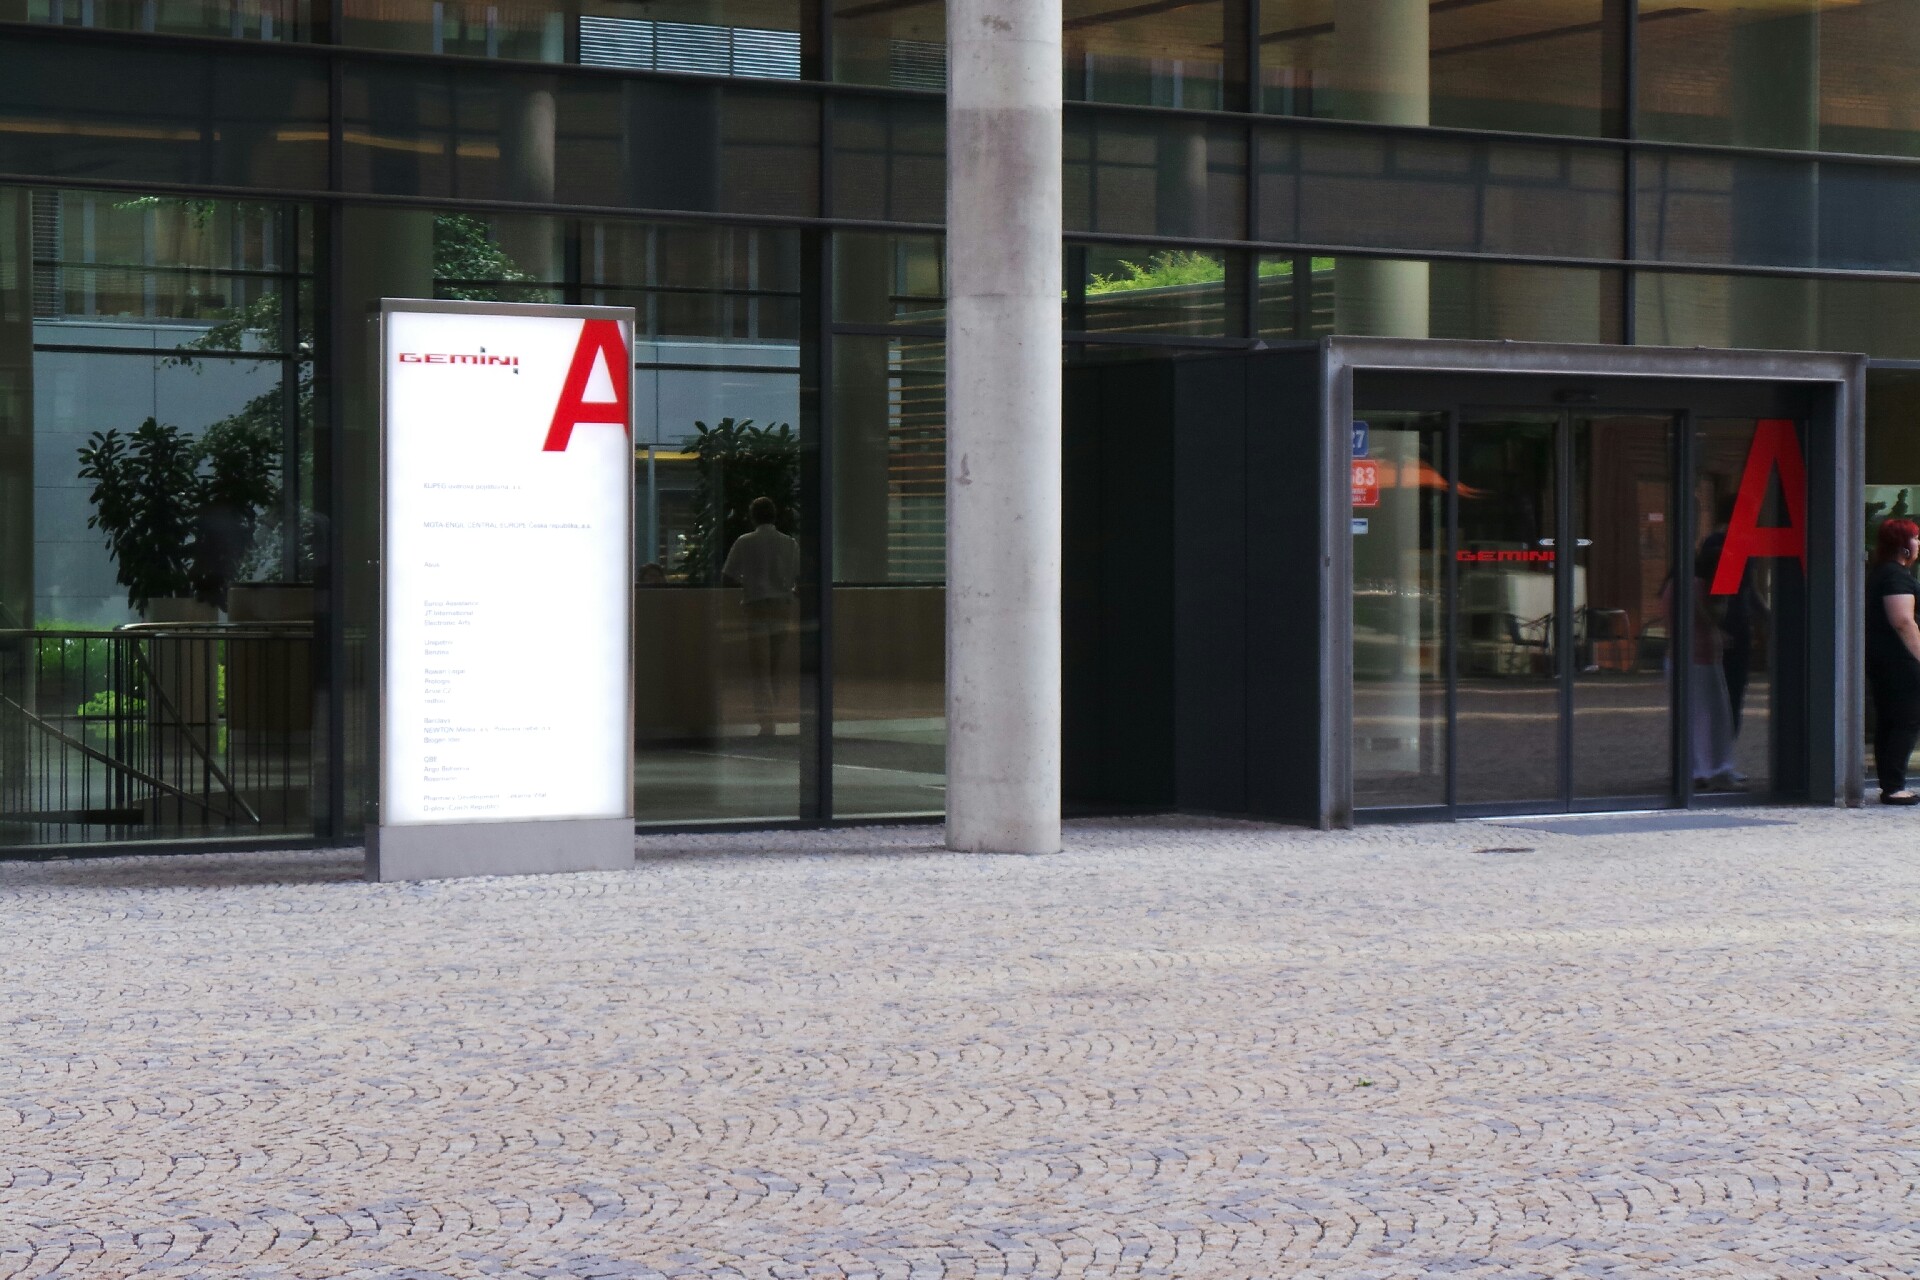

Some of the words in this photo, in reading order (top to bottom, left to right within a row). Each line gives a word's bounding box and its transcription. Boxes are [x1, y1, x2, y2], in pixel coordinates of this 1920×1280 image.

[399, 349, 520, 370] GEMINI
[542, 319, 628, 451] A
[1353, 467, 1376, 486] 83
[1710, 420, 1807, 595] A
